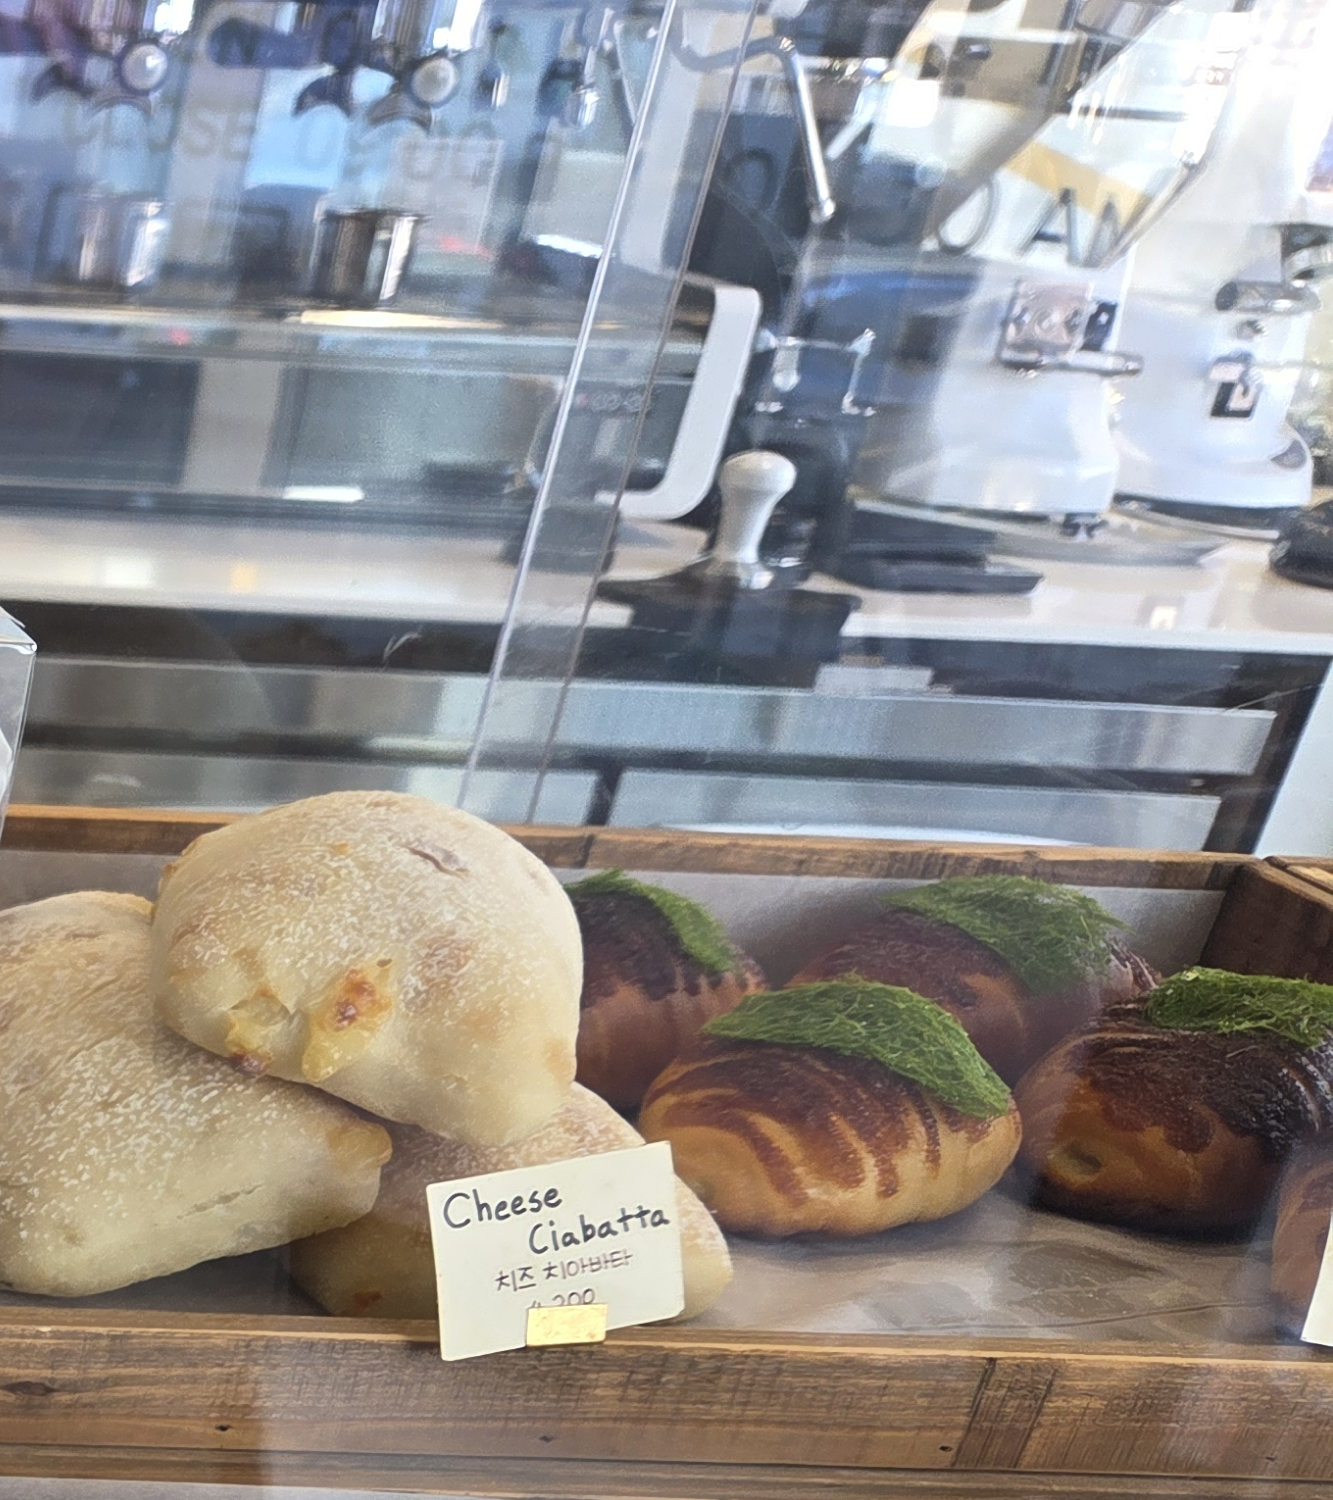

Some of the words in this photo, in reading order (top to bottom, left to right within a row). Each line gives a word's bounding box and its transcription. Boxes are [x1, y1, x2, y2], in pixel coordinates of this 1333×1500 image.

[443, 1187, 563, 1229] Cheese
[528, 1204, 670, 1254] Ciabatta
[495, 1266, 537, 1292] 치즈
[542, 1248, 633, 1280] 치아바타
